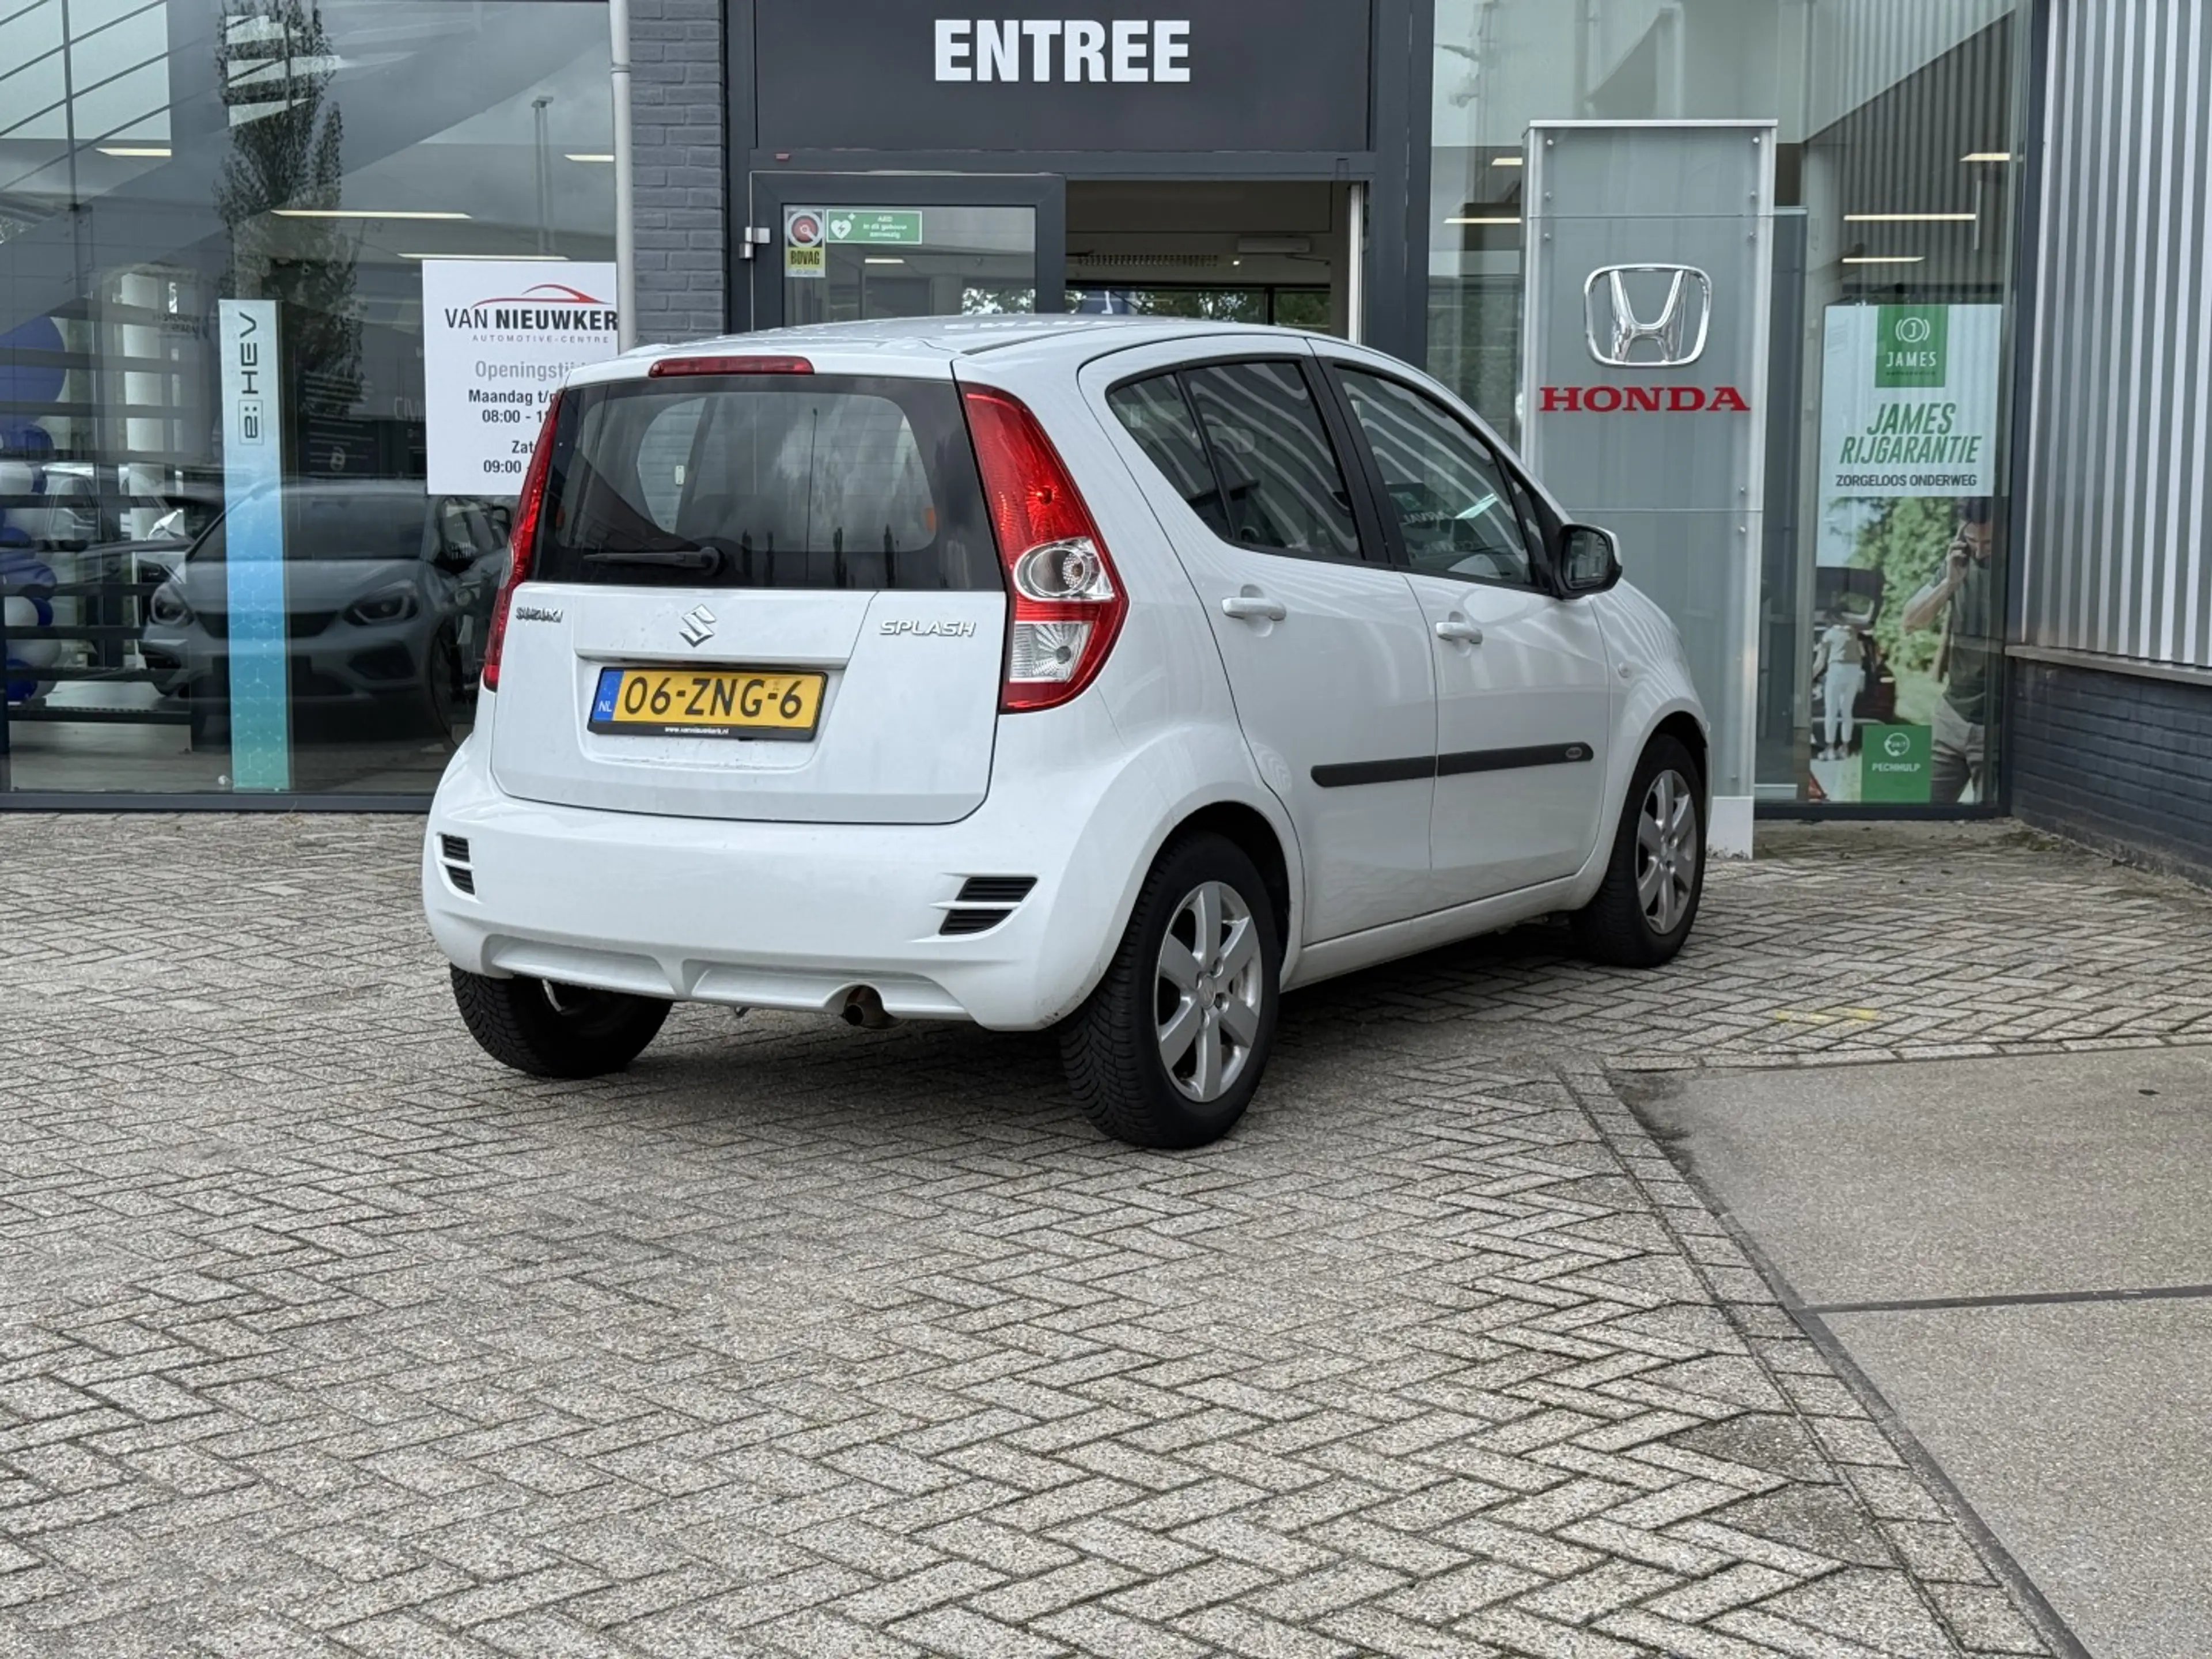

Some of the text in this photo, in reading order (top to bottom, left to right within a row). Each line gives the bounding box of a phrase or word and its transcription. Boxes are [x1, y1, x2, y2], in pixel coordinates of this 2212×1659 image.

[935, 20, 1191, 82] ENTREE
[790, 250, 820, 265] BOVAG
[445, 308, 488, 328] VAN
[472, 334, 609, 344] AUTOMOTIVE-CENTRE
[1885, 351, 1937, 368] JAMES
[469, 389, 533, 406] Maandag
[1540, 386, 1750, 412] HONDA
[482, 410, 521, 423] 08:00
[1866, 403, 1956, 435] JAMES
[1840, 436, 1982, 464] RIJGARANTIE
[483, 460, 522, 473] 09:00
[1836, 475, 1977, 486] ZORGELOOS ONDERWEG
[880, 620, 976, 637] SPLASH
[599, 676, 802, 719] NL 06-ZNG-6
[1872, 763, 1921, 772] PECHHULP
